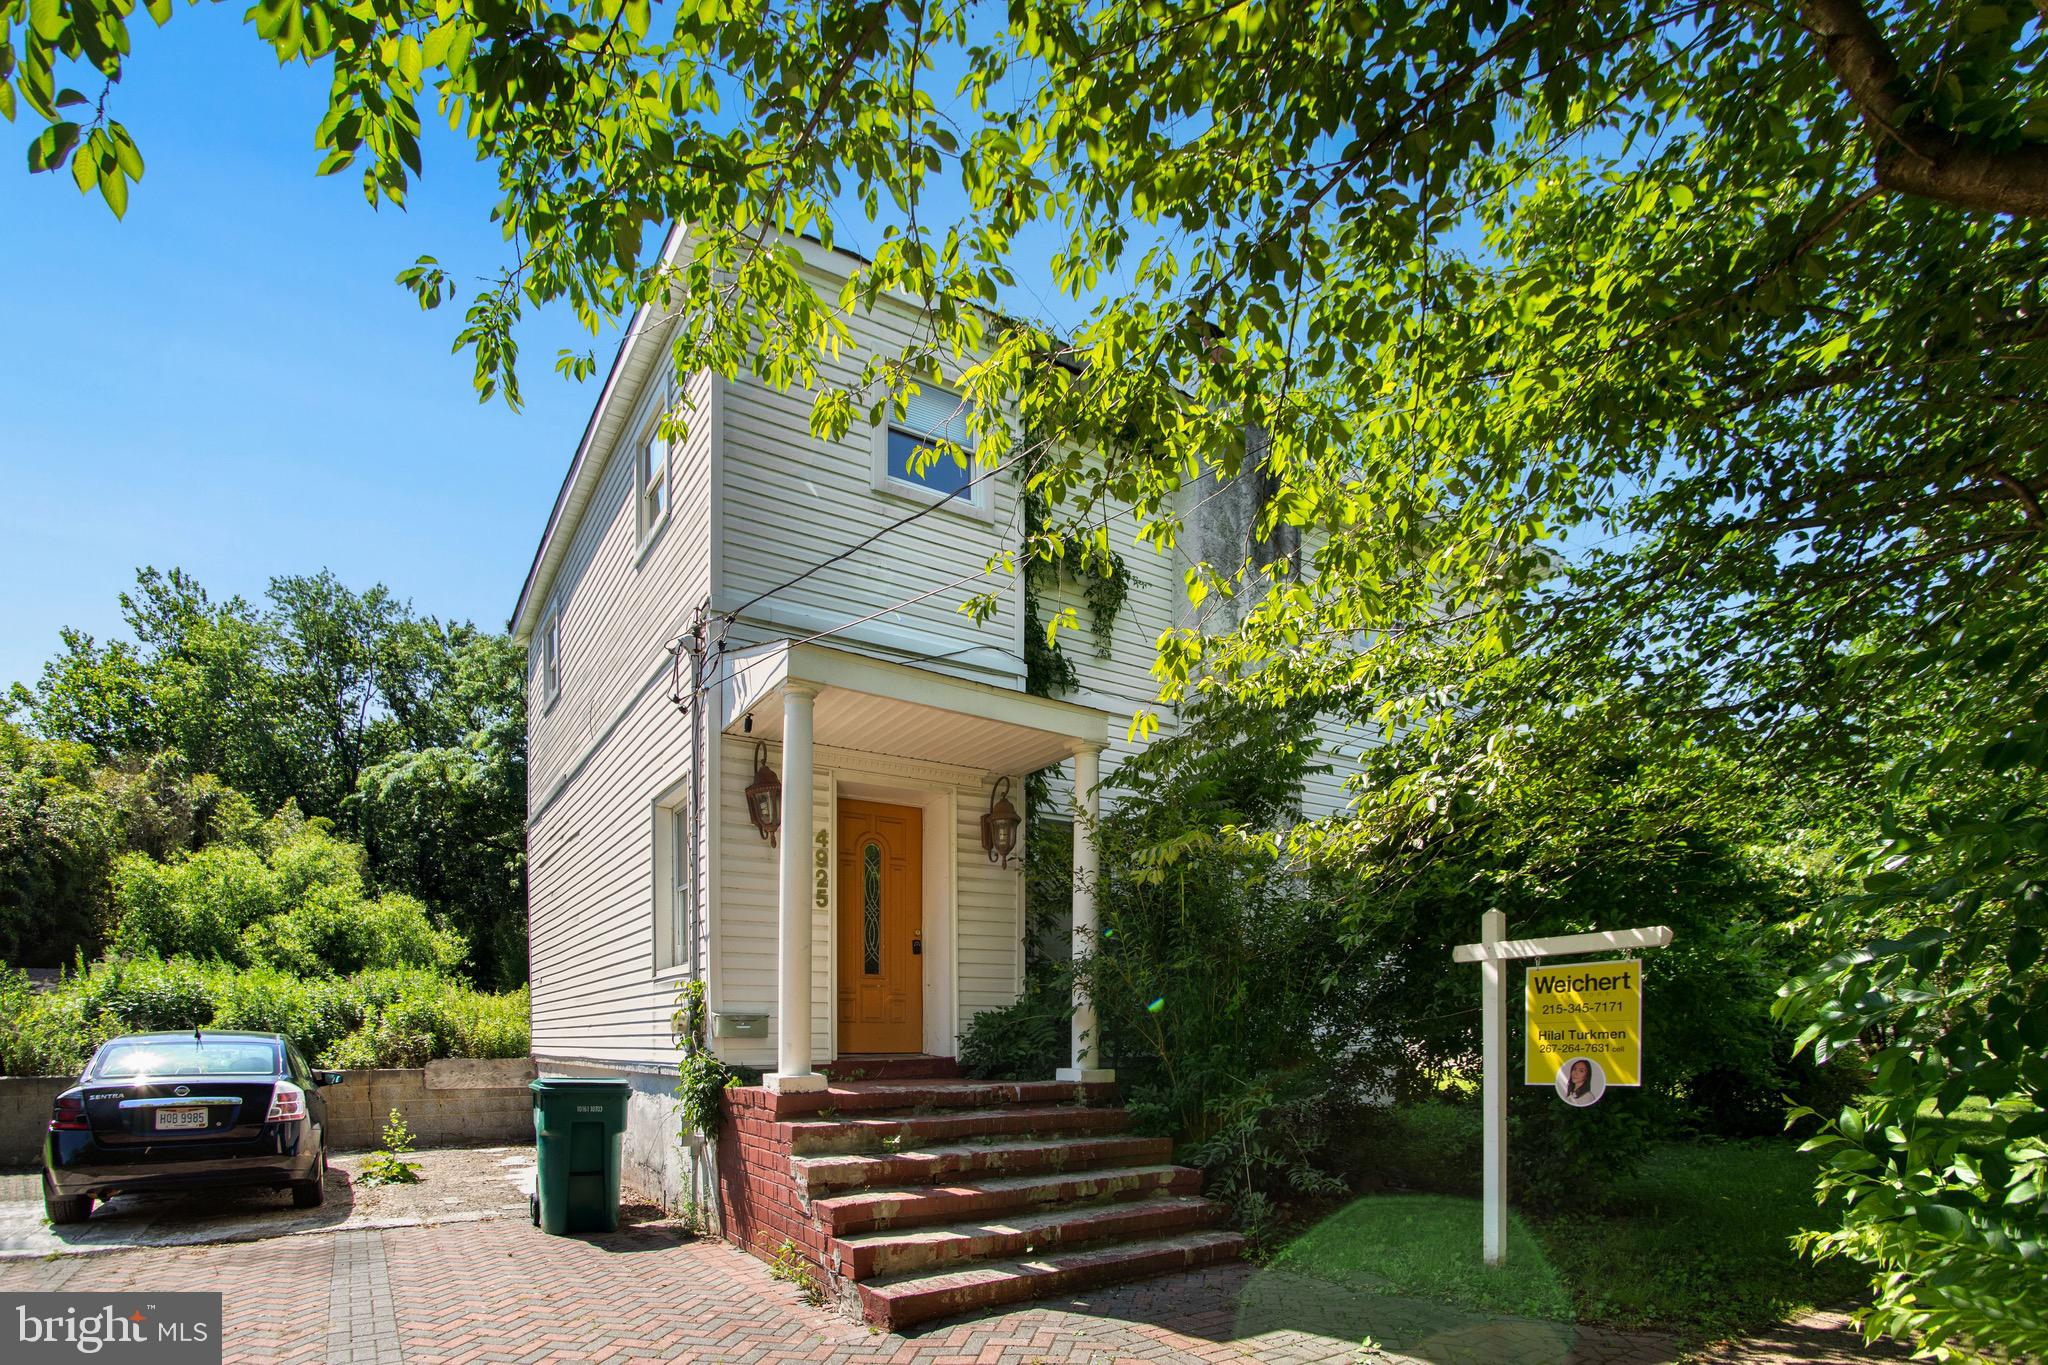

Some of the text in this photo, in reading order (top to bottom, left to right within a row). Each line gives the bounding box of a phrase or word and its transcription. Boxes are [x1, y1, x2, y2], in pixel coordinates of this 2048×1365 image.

[815, 828, 829, 909] 4925
[1534, 971, 1631, 994] Weichert
[1542, 1001, 1623, 1015] 215-345-7171
[1538, 1029, 1626, 1041] Hilal Turkmen
[1539, 1043, 1610, 1054] 267-264-7631
[88, 1093, 125, 1101] SENTRA
[181, 1112, 204, 1124] 9985
